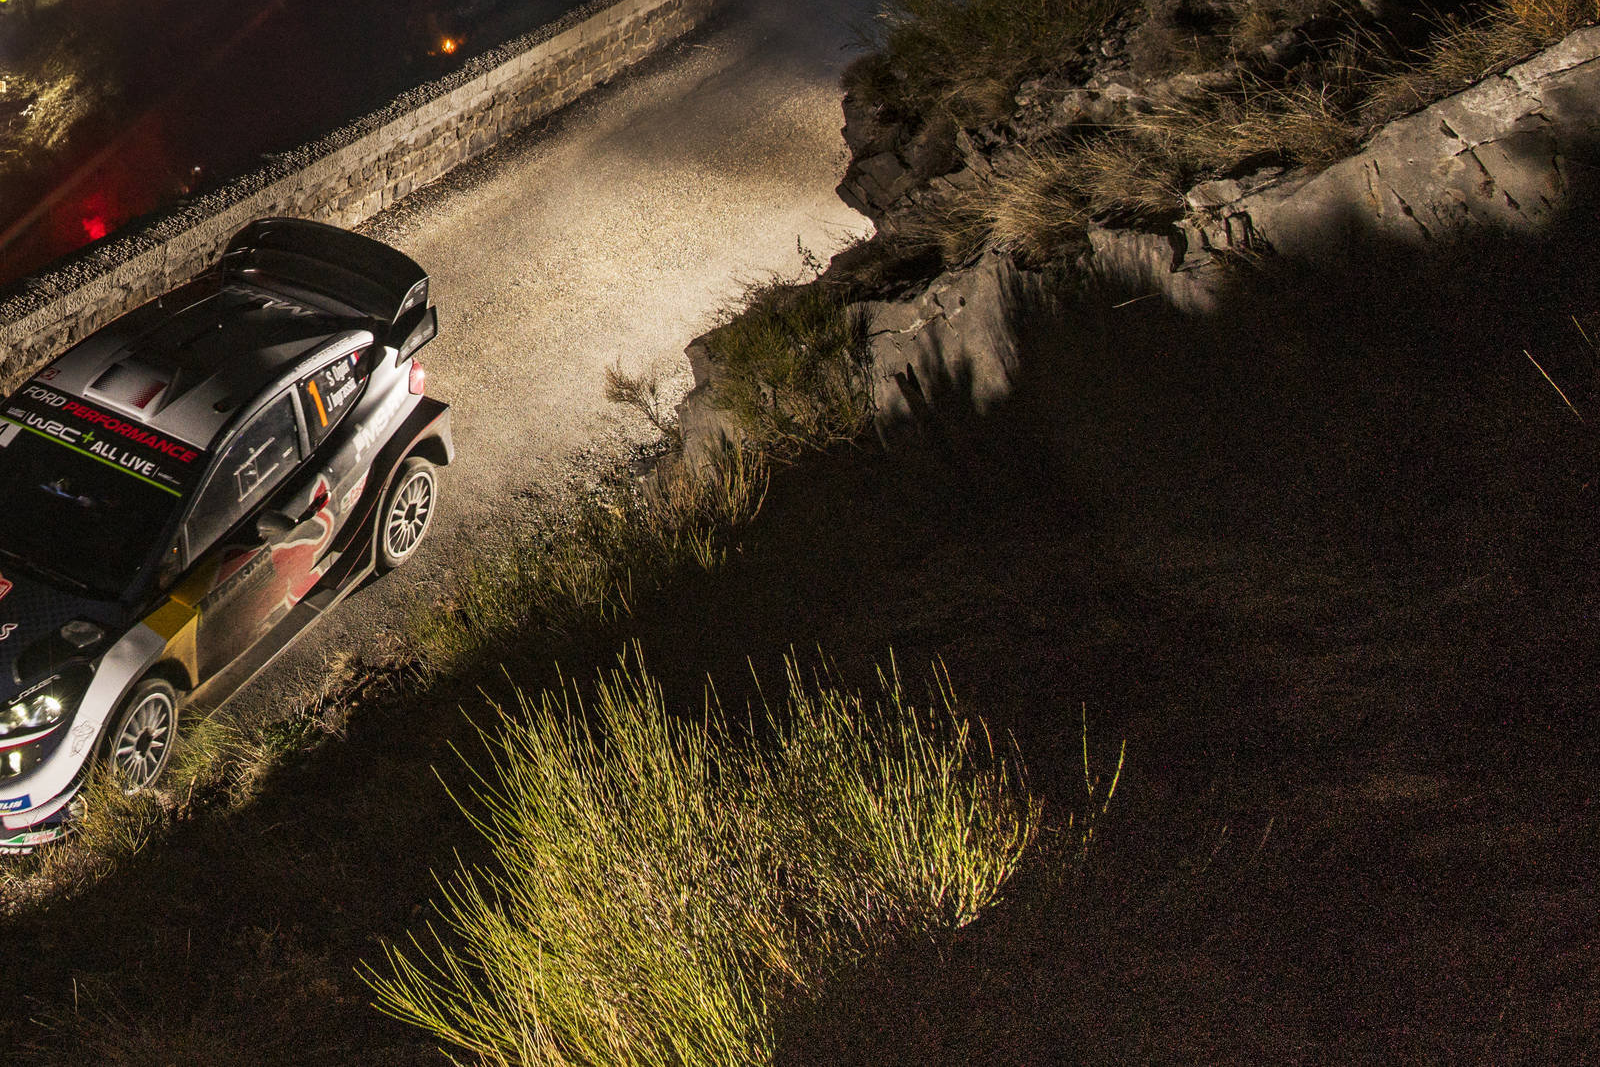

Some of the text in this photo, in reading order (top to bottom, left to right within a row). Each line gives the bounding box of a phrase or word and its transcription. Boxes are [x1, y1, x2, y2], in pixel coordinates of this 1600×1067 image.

[325, 369, 335, 387] S
[308, 379, 328, 428] 1
[327, 395, 334, 413] J
[23, 386, 199, 463] FORD PERFORMANCE
[90, 441, 116, 461] ALL
[119, 452, 155, 476] LIVE
